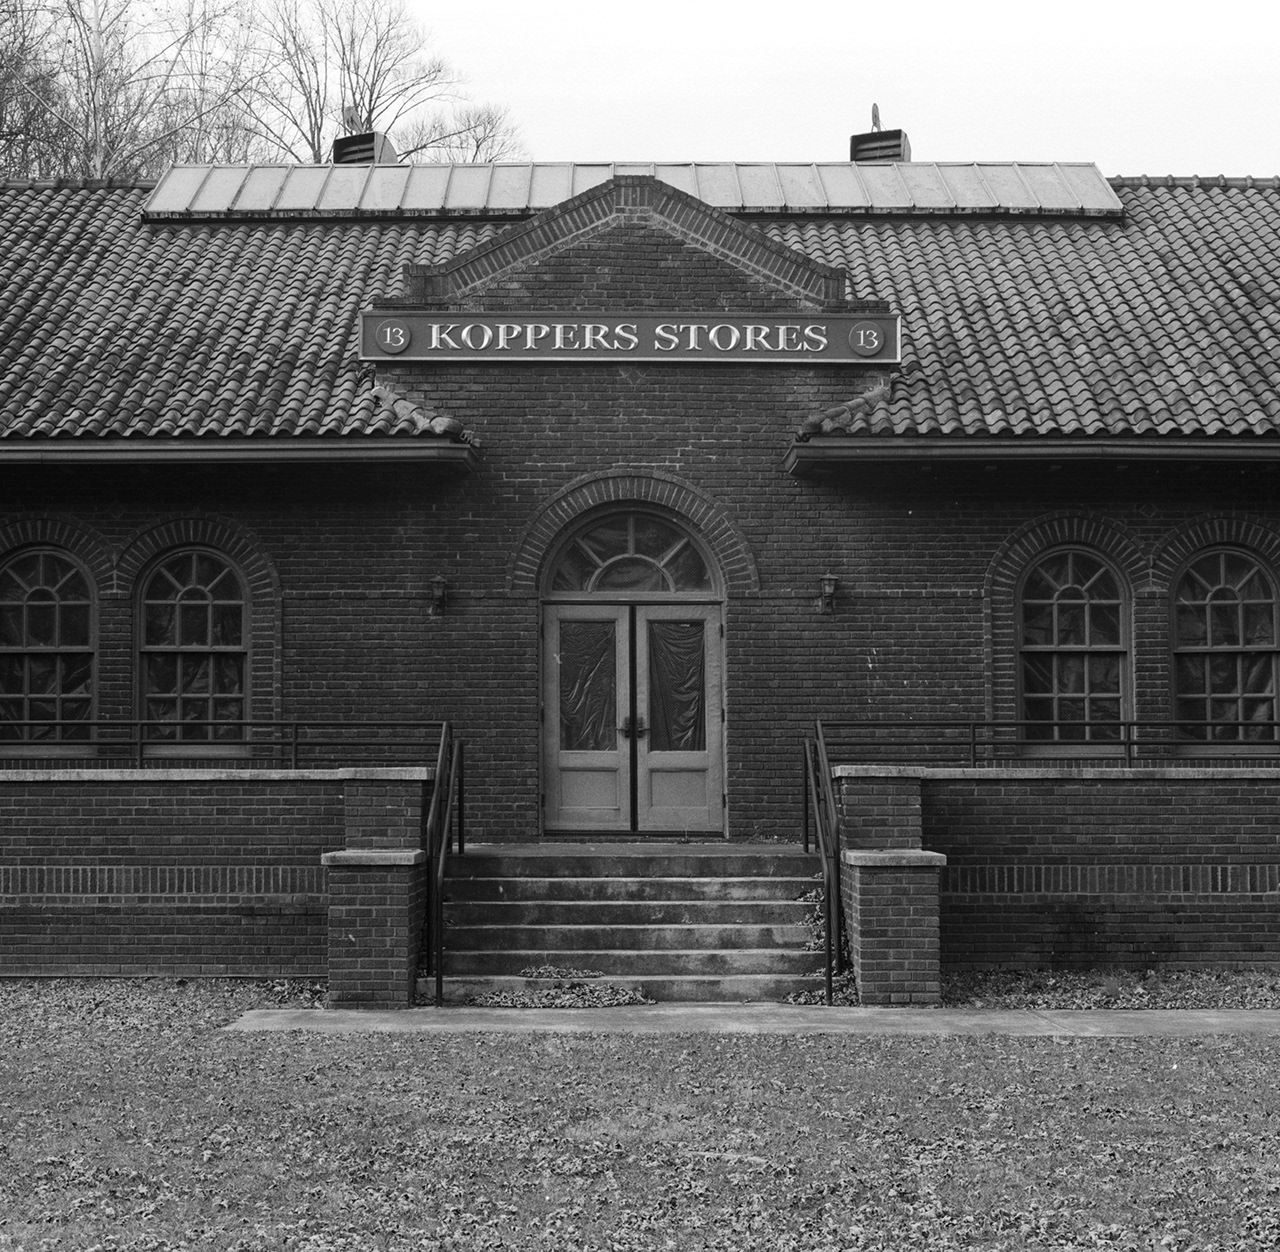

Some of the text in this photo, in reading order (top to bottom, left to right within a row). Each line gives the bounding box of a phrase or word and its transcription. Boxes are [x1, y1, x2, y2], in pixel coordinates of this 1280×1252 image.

[383, 323, 879, 352] 13 KOPPERS STORES 13
